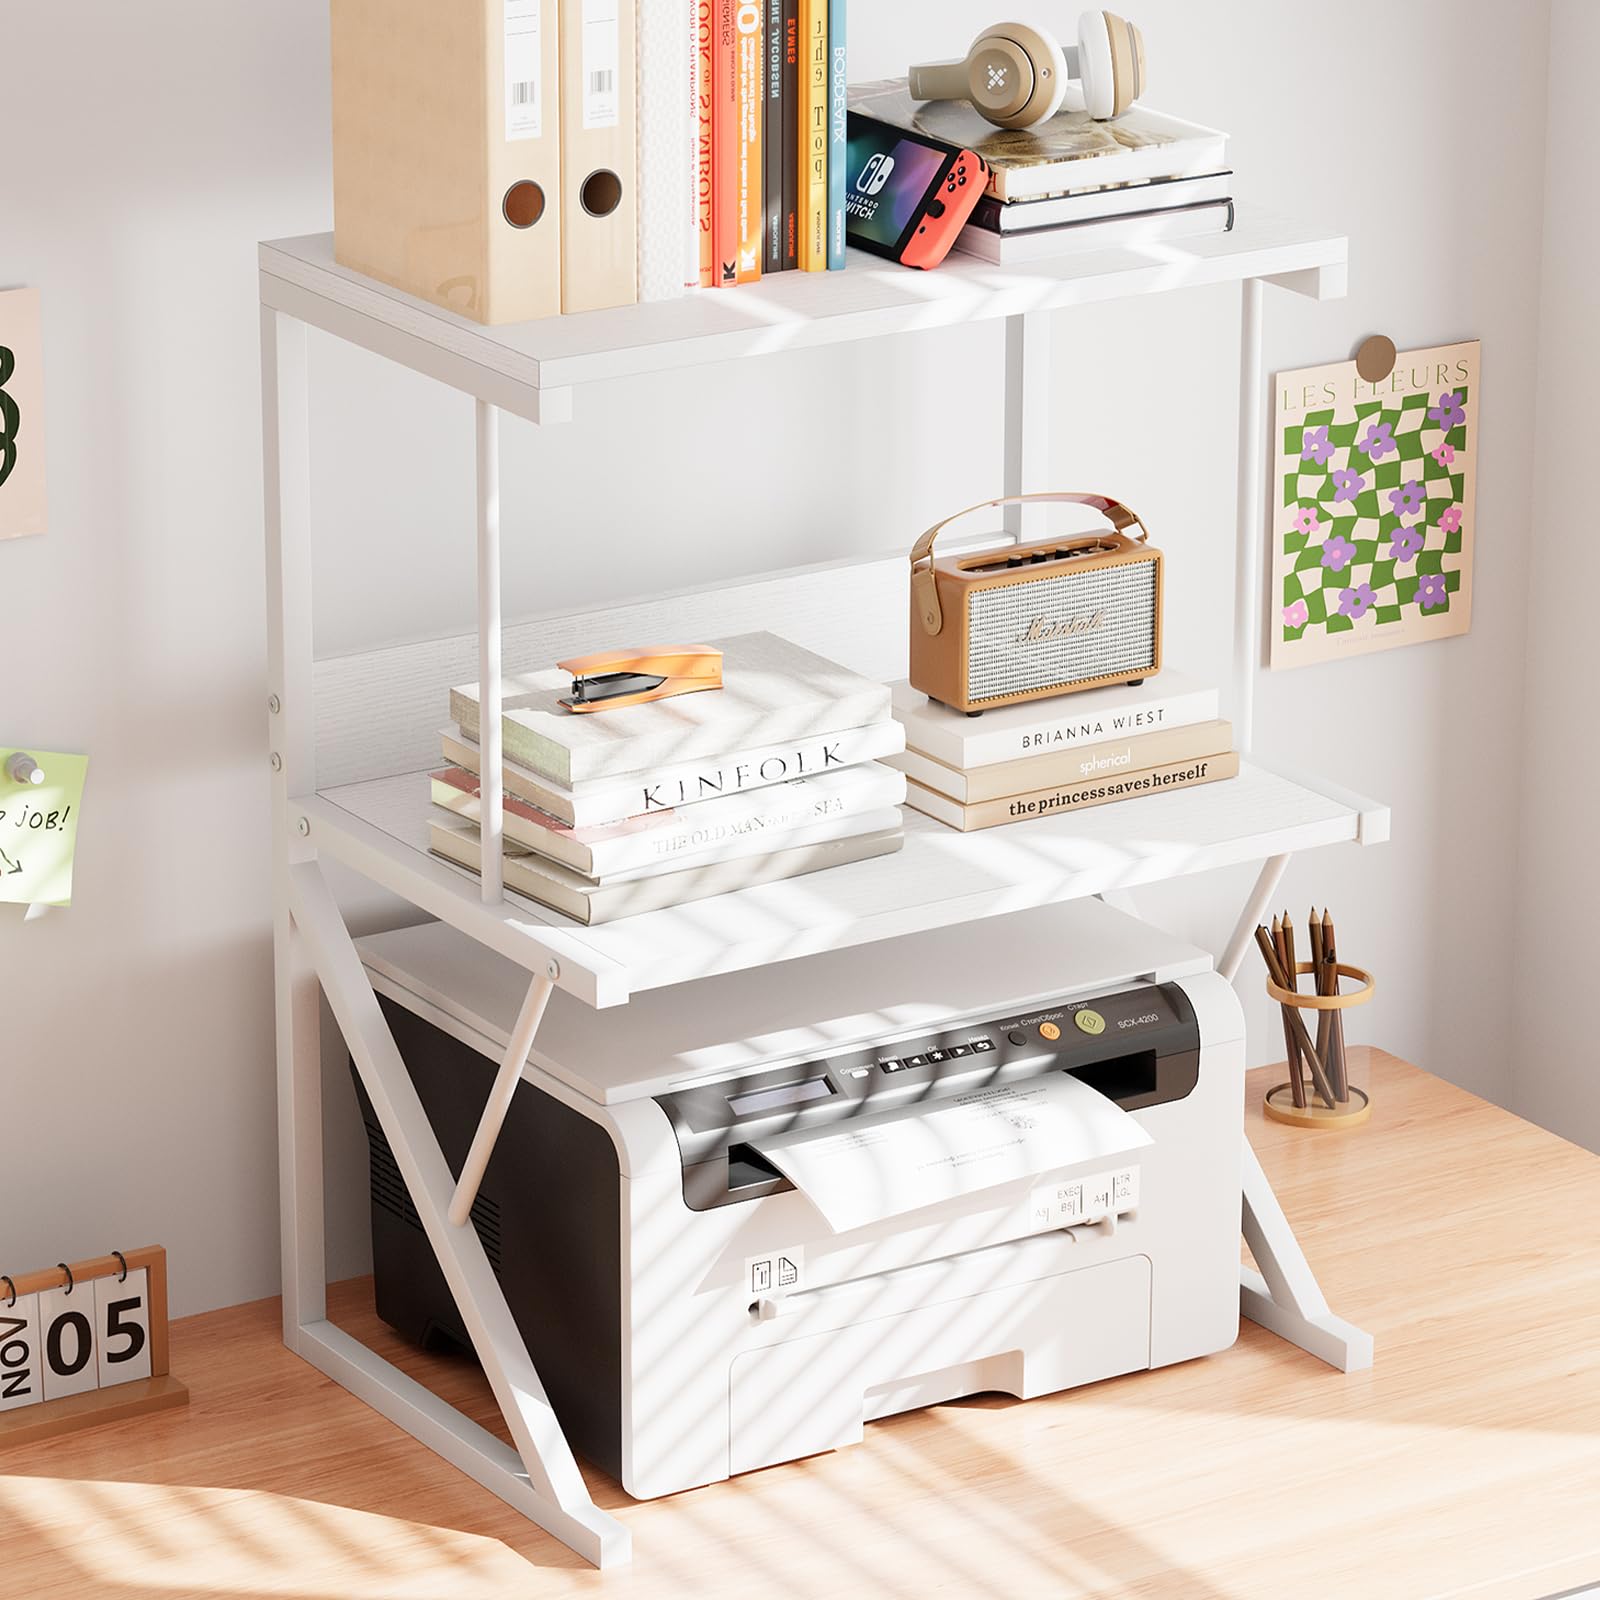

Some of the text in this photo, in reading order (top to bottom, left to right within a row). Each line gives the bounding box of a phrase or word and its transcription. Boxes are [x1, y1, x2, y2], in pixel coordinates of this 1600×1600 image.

[846, 192, 880, 210] INTENDO
[1284, 382, 1337, 411] LES
[1014, 609, 1107, 645] Marshall
[1022, 708, 1165, 749] BRIANNA WIEST
[643, 742, 846, 810] KINFOLK
[1079, 746, 1131, 776] spherical
[1009, 763, 1208, 816] the princess saves herself
[1117, 1013, 1160, 1029] SCX-4200
[0, 1316, 32, 1399] NOV
